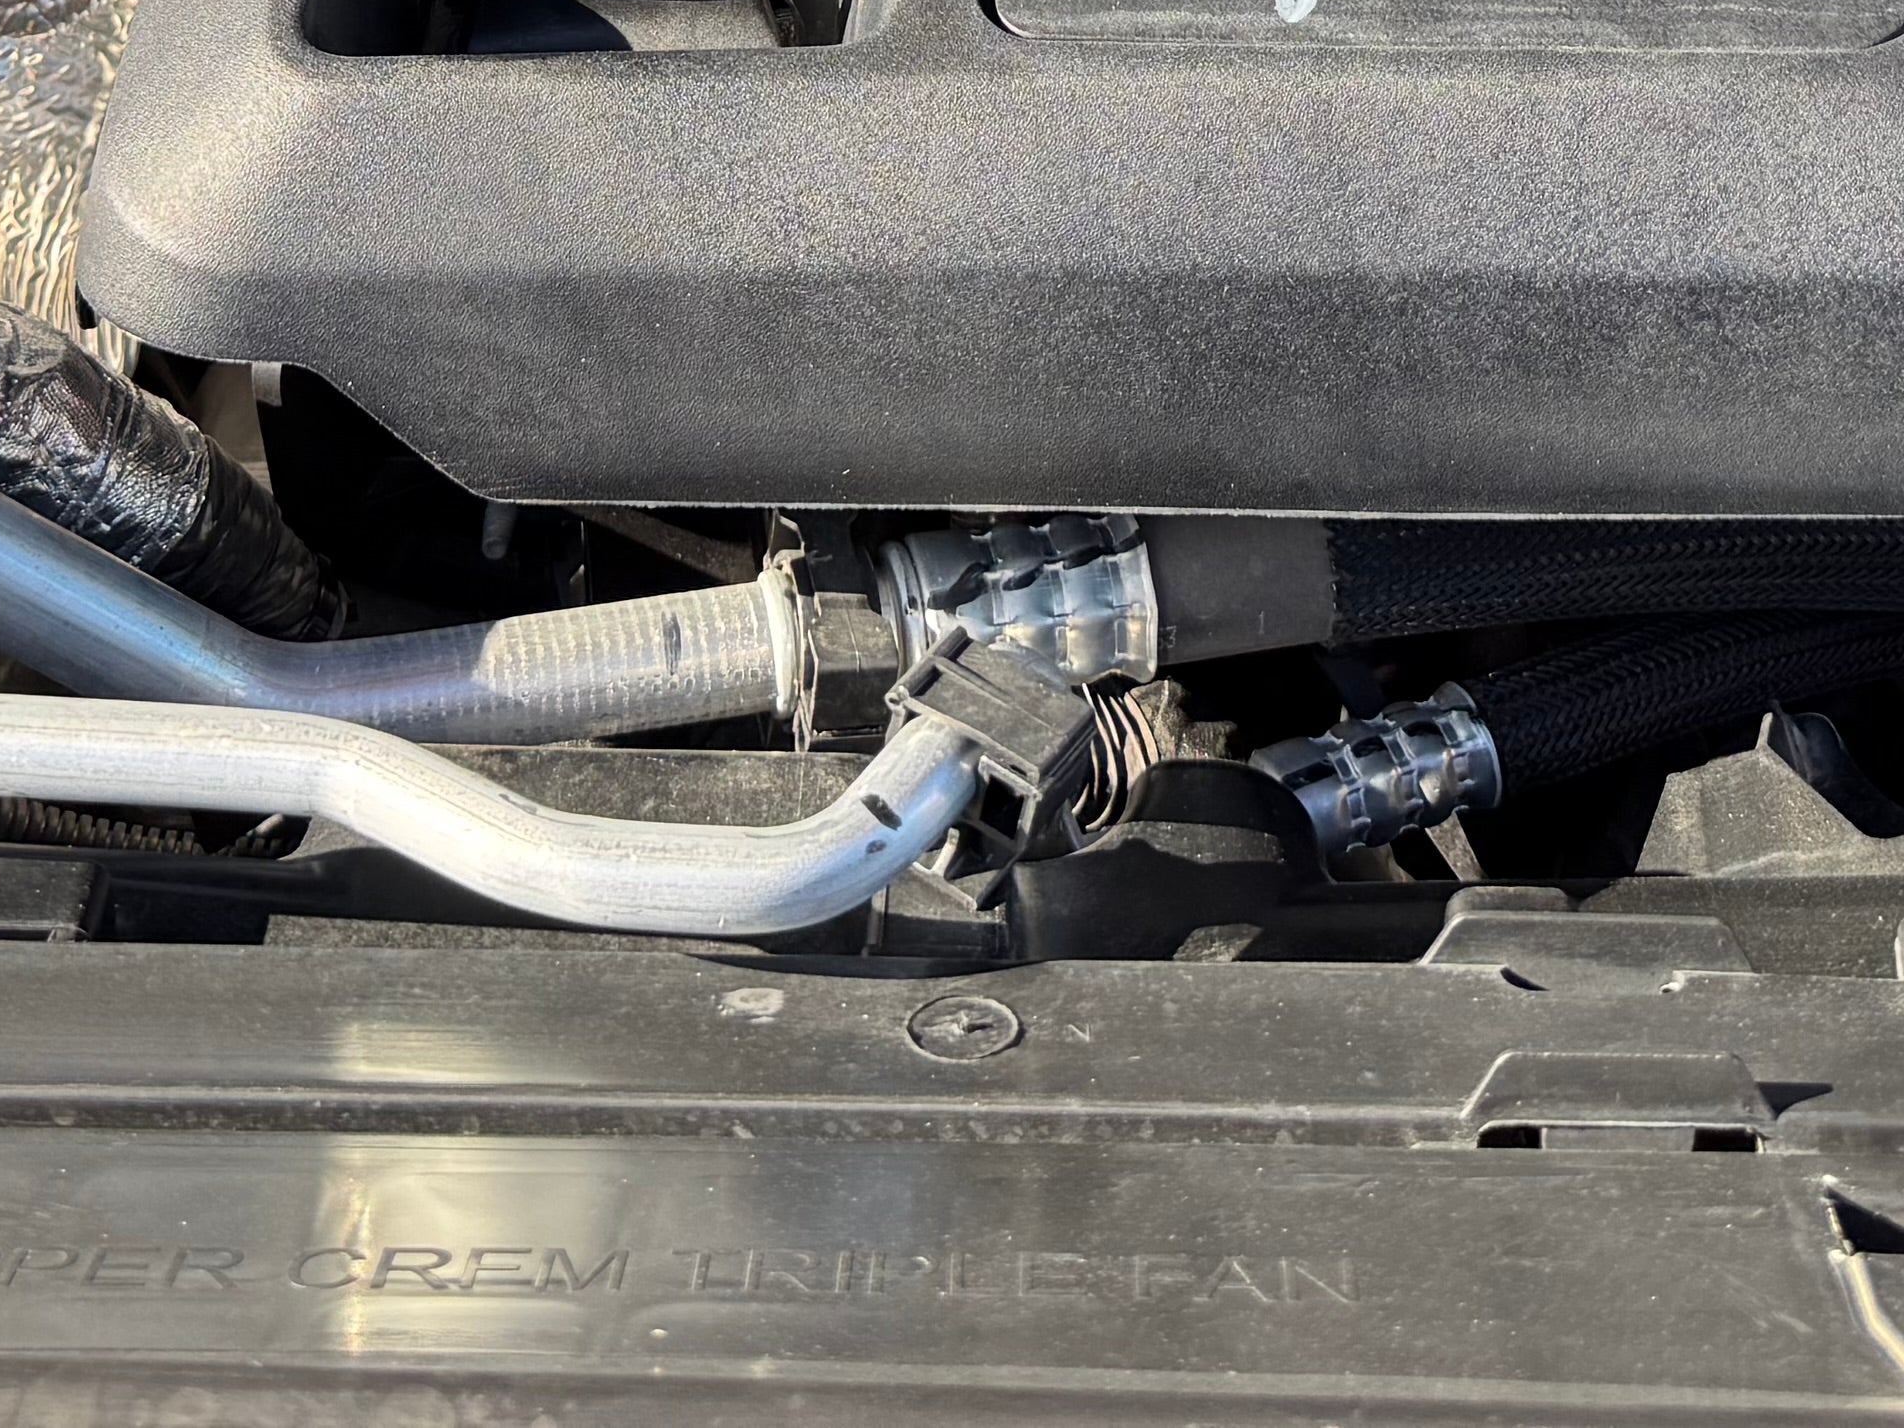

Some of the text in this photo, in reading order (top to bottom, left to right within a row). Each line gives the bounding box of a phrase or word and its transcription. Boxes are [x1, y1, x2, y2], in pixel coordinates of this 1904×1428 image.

[287, 1245, 632, 1293] CRFM
[670, 1247, 1093, 1298] TRIPLE
[1131, 1252, 1362, 1304] FAN
